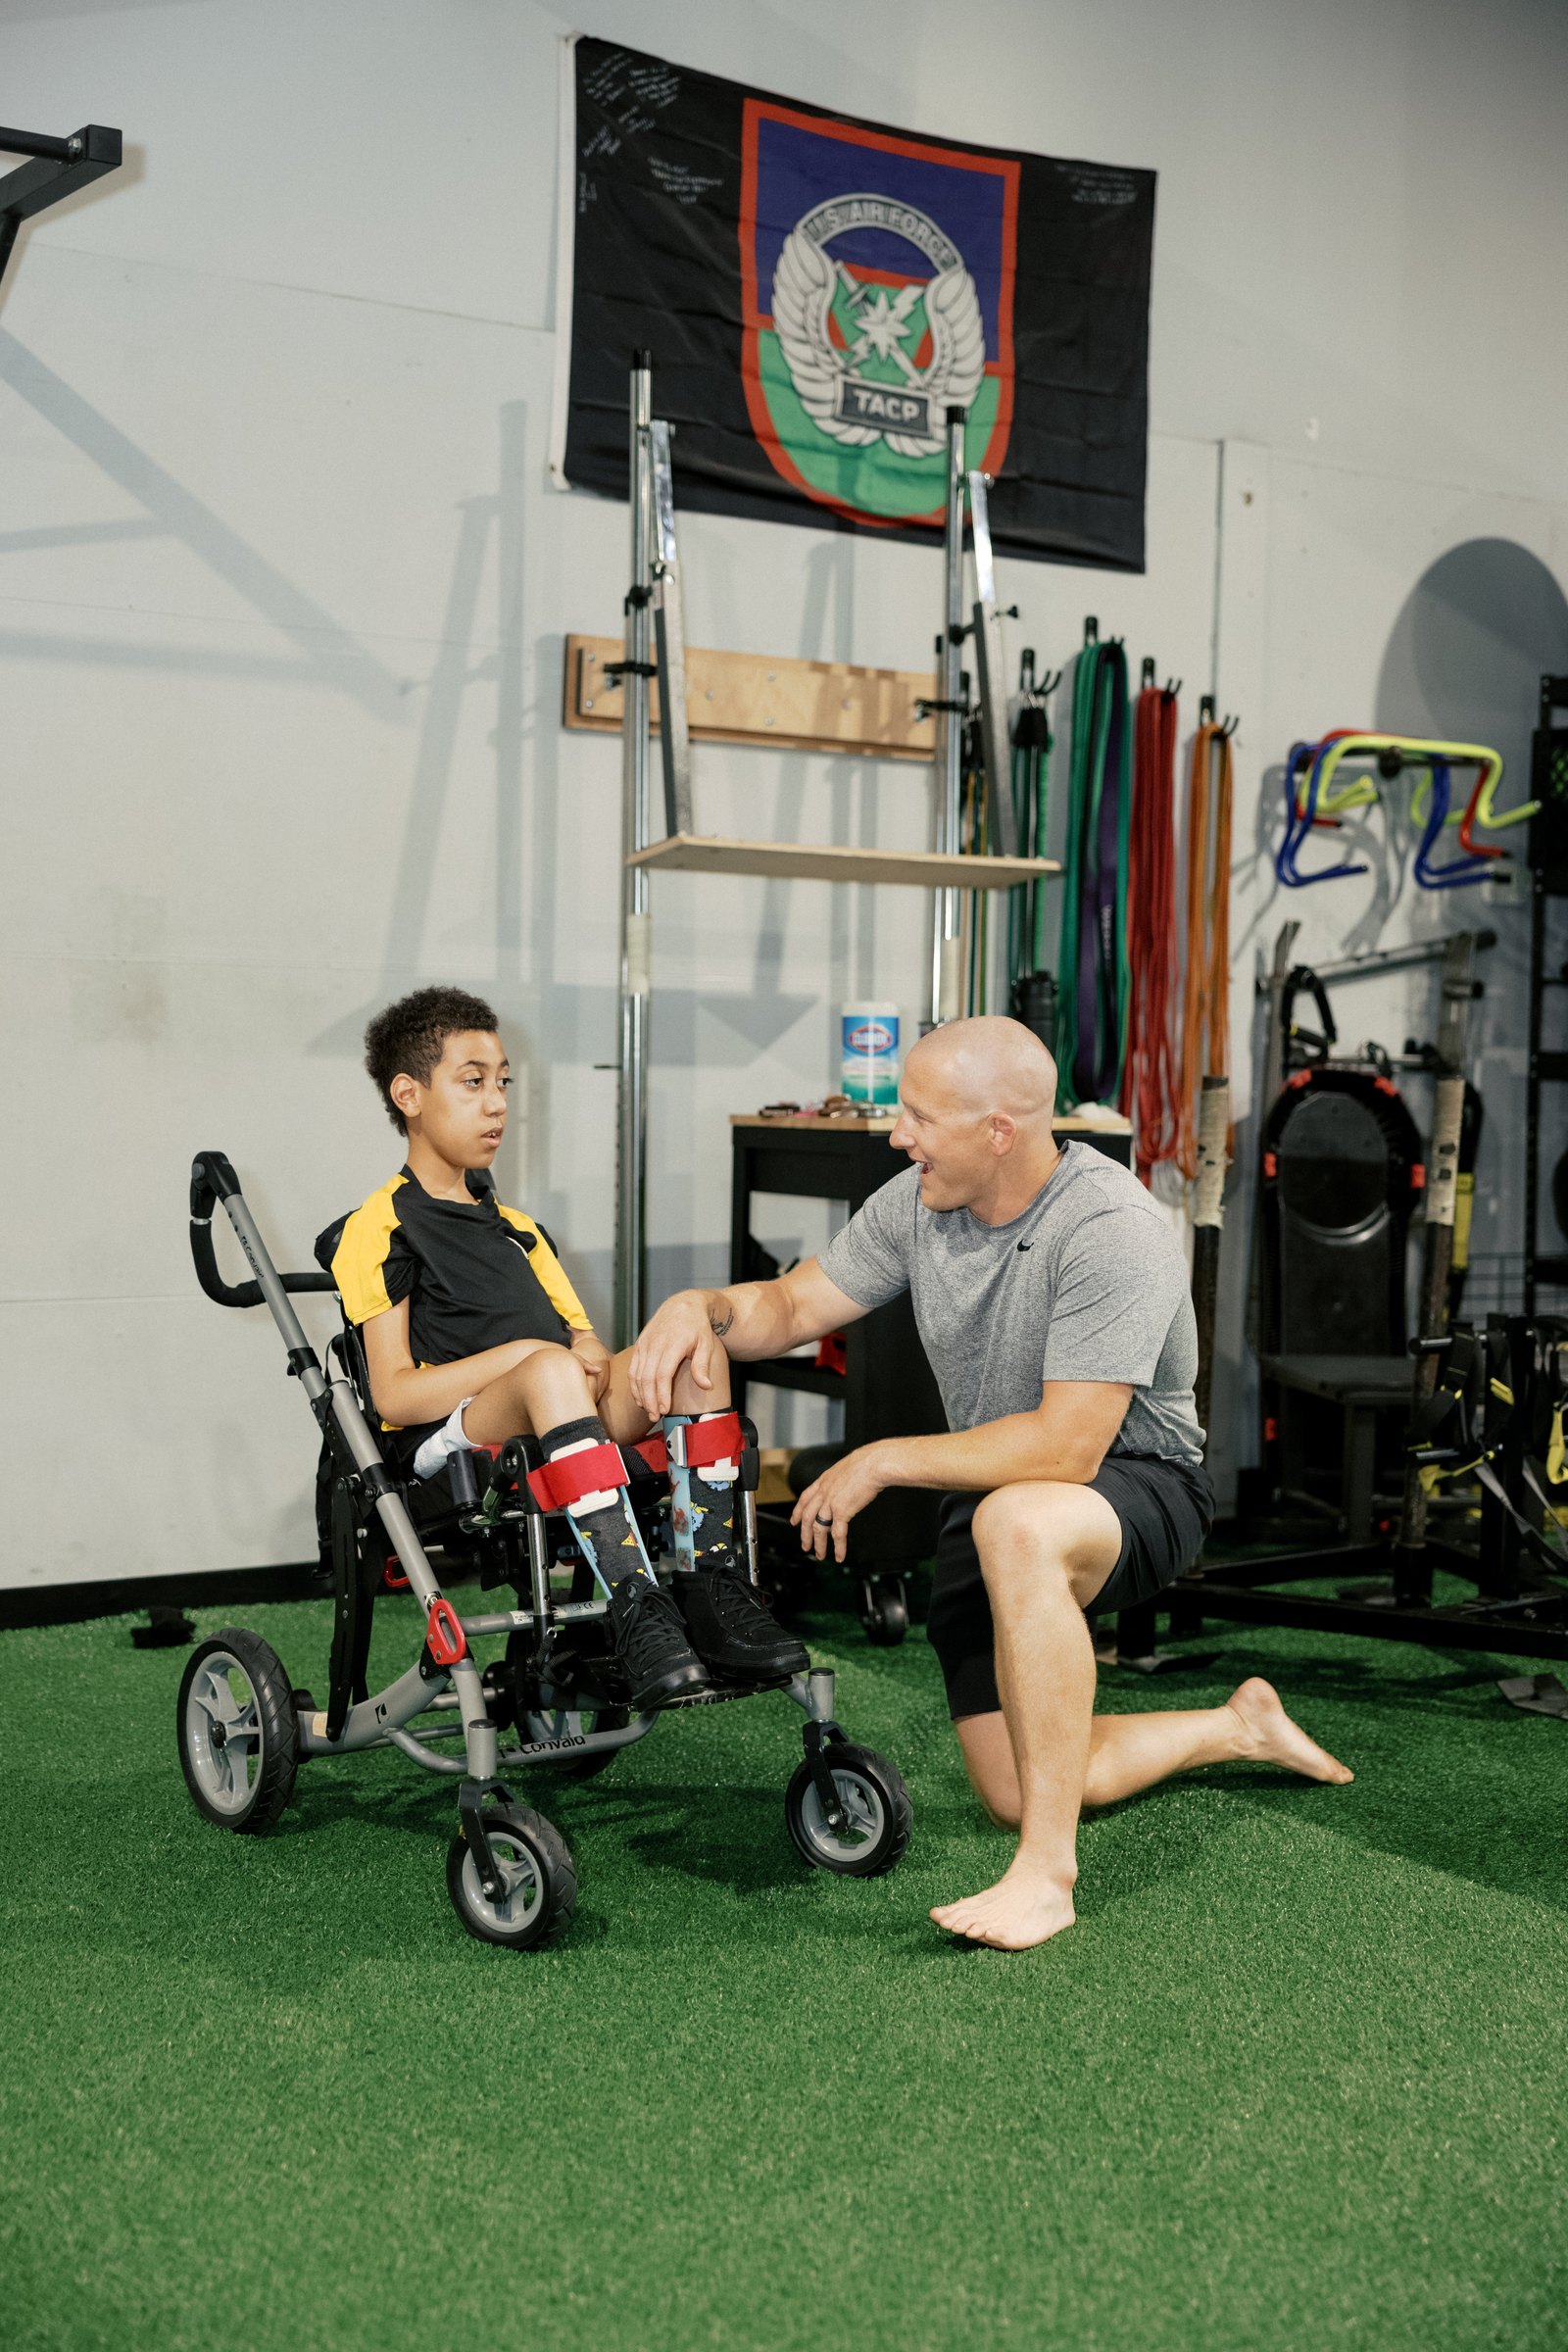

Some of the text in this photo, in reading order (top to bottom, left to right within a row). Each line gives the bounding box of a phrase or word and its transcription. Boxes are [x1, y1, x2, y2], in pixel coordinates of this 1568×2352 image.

[849, 201, 885, 222] AIR
[888, 207, 958, 270] FORCE
[853, 388, 920, 421] TACP
